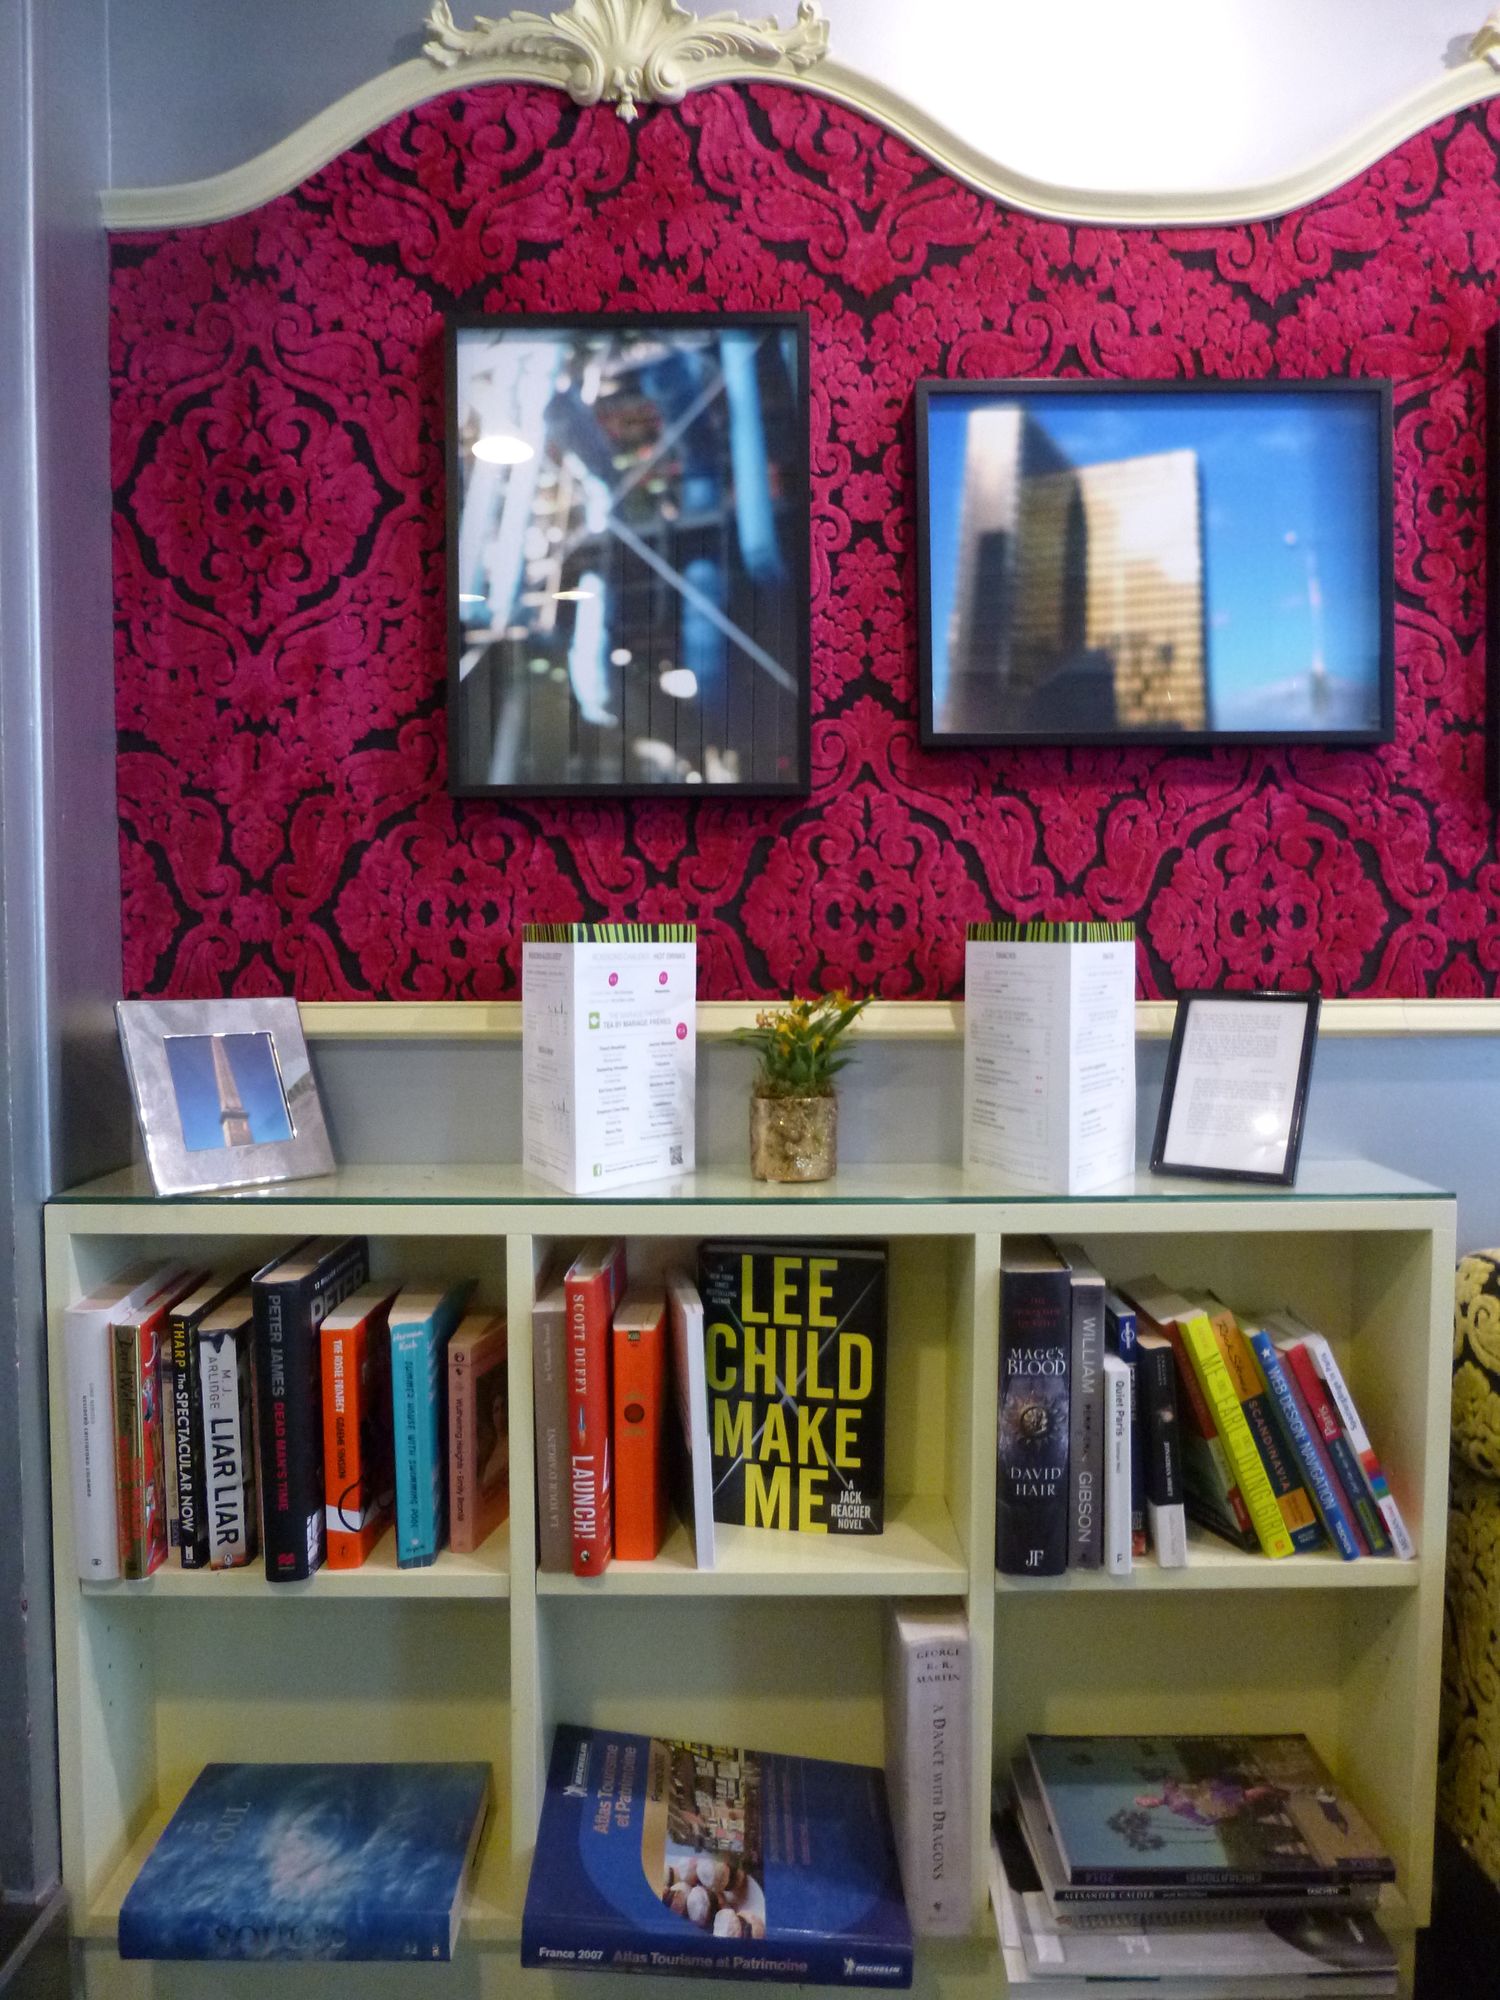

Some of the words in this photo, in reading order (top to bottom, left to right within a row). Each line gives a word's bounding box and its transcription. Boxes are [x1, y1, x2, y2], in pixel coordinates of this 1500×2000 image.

[741, 1254, 838, 1327] LEE
[268, 1295, 282, 1344] PETER
[573, 1295, 585, 1341] SCOTT
[172, 1321, 186, 1368] THARP
[706, 1323, 873, 1401] CHILD
[1008, 1358, 1066, 1375] BLOOD
[1083, 1317, 1096, 1393] WILLIAM
[177, 1373, 185, 1391] The
[206, 1356, 220, 1410] ARLIDGE
[270, 1345, 285, 1397] JAMES
[574, 1346, 587, 1395] DUFFY
[1115, 1380, 1125, 1408] Quiet
[175, 1391, 192, 1490] SPECTACULAR
[713, 1398, 862, 1469] MAKE
[1115, 1410, 1125, 1437] Paris
[1268, 1367, 1288, 1395] WEB
[1299, 1442, 1337, 1510] NAVIGATION
[1316, 1406, 1337, 1437] Paris
[211, 1418, 235, 1478] LIAR
[1249, 1401, 1290, 1491] SCANDINAVIA
[848, 1479, 854, 1490] A
[1010, 1466, 1064, 1481] DAVID
[1015, 1482, 1056, 1496] HAIR
[180, 1494, 194, 1532] NOW
[214, 1485, 239, 1546] LIAR
[571, 1455, 596, 1539] LAUNCH!
[745, 1463, 829, 1534] ME
[831, 1503, 871, 1519] REACHER
[840, 1490, 862, 1504] JACK
[1078, 1471, 1093, 1543] GIBSON
[838, 1518, 863, 1530] NOVEL
[1025, 1549, 1044, 1567] JF
[917, 1674, 959, 1684] MARTIN
[933, 1704, 944, 1713] A
[933, 1718, 946, 1766] DANCE
[597, 1744, 618, 1799] Tourisme
[615, 1746, 636, 1812] Patrimoine
[932, 1772, 943, 1805] WITH
[593, 1800, 612, 1834] Atlas
[615, 1813, 630, 1828] et
[932, 1811, 946, 1880] DRAGONS
[1063, 1891, 1117, 1900] ALEXANDER
[1119, 1890, 1155, 1899] CALDER
[539, 1946, 576, 1960] France
[577, 1948, 603, 1961] 2007
[613, 1950, 648, 1964] Atlas
[651, 1951, 712, 1967] Tourisme
[716, 1955, 730, 1967] et
[733, 1955, 808, 1972] Patrimoine
